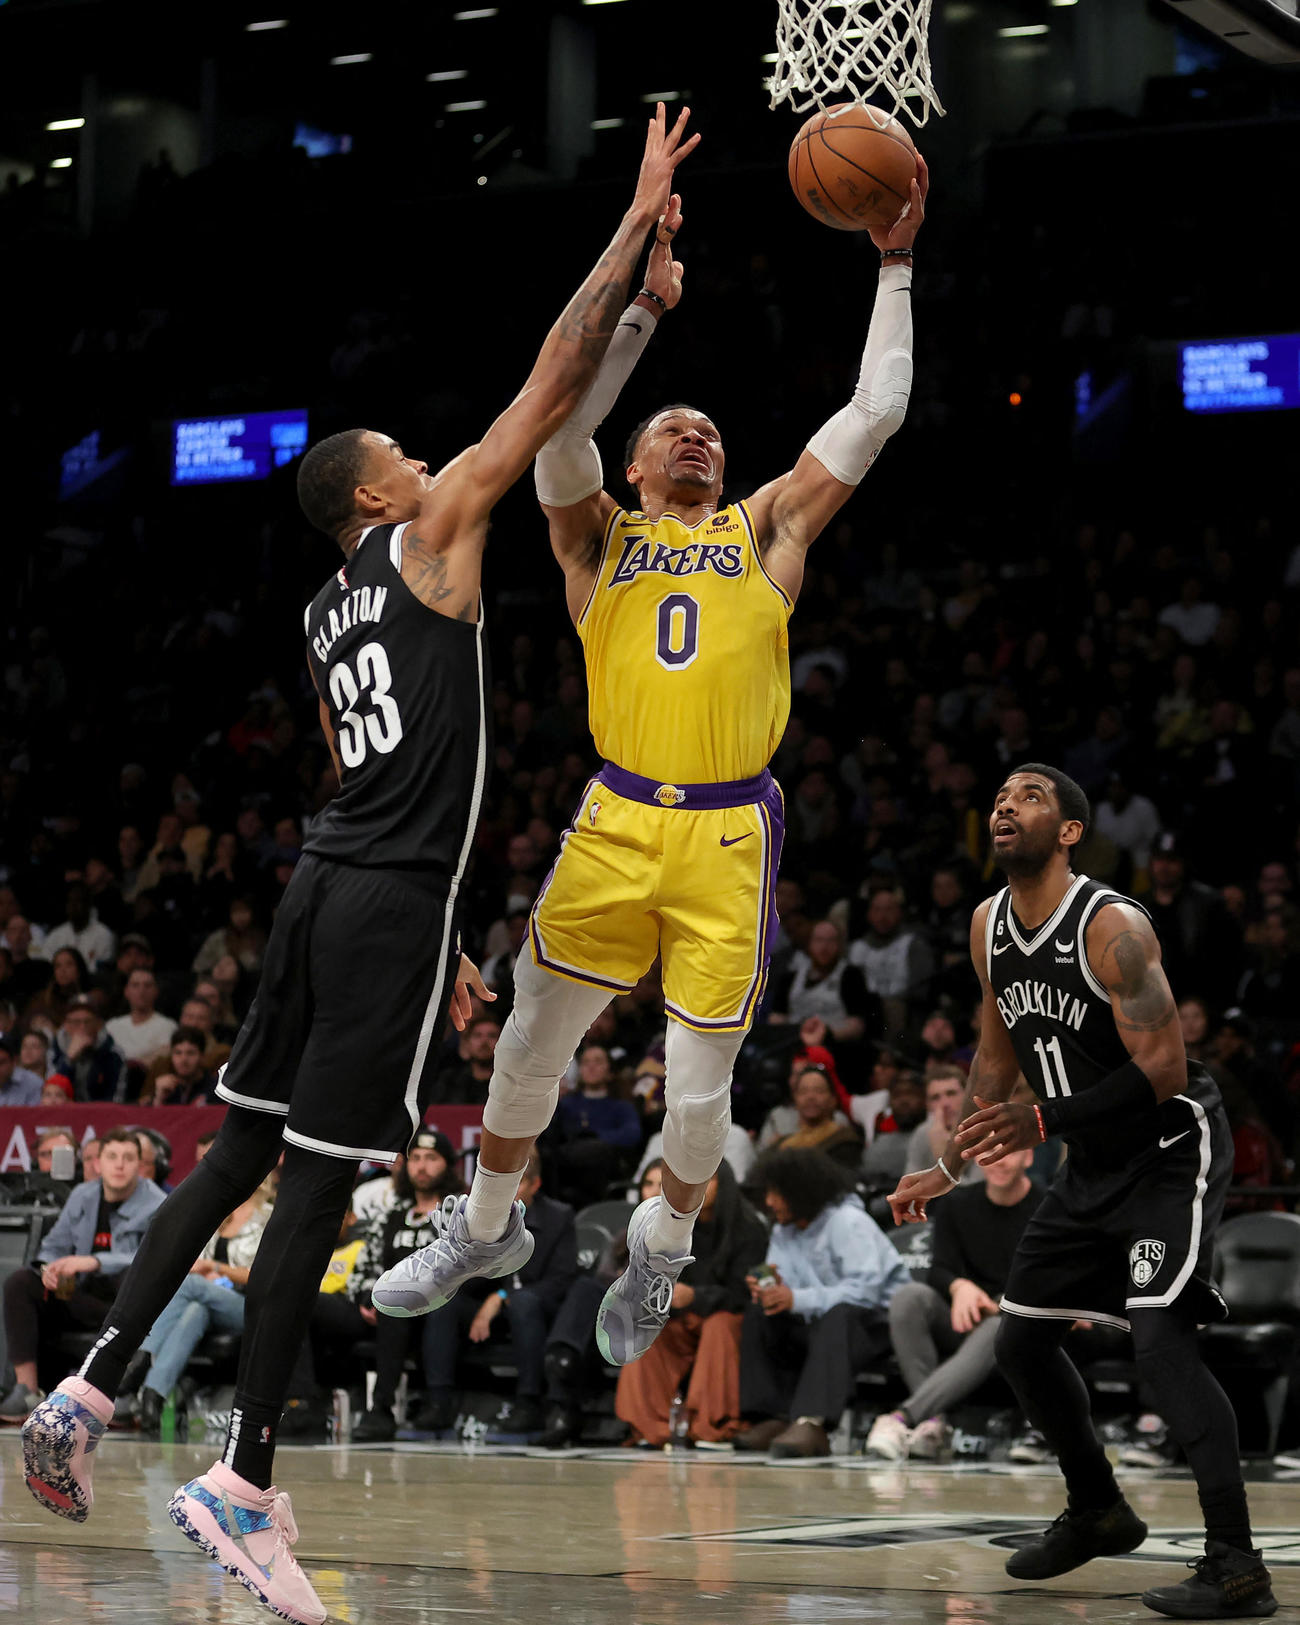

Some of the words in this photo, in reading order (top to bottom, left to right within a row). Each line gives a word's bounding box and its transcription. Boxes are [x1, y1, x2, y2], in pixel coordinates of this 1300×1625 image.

[706, 523, 739, 535] bibigo
[608, 535, 744, 590] LAKERS
[313, 586, 388, 663] CLAXTON
[655, 592, 700, 671] 0
[329, 642, 403, 768] 33
[996, 920, 1004, 935] 6
[1055, 956, 1074, 964] Webull
[1033, 1036, 1072, 1098] 11
